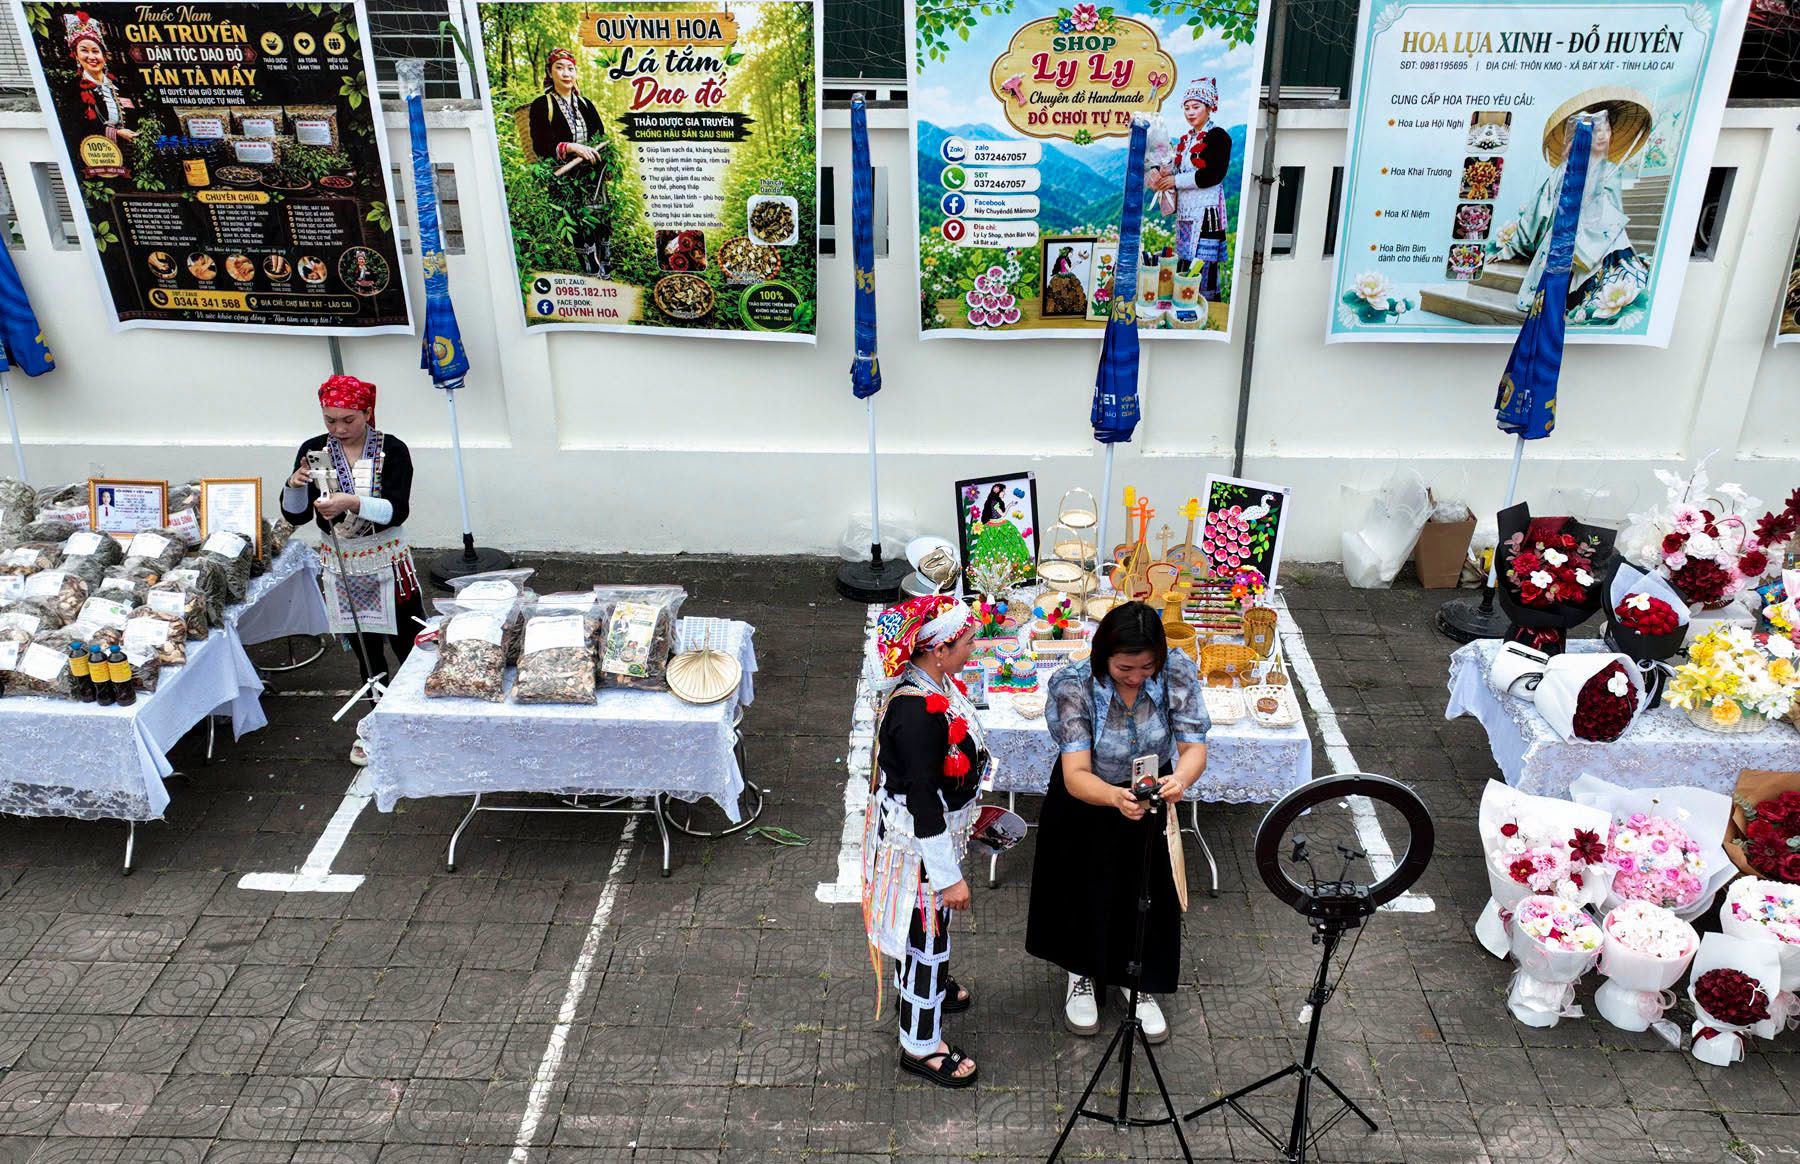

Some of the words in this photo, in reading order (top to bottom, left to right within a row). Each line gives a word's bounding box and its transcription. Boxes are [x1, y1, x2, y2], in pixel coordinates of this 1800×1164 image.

[135, 5, 174, 22] Thuốc
[177, 5, 212, 22] Nam
[125, 24, 162, 43] GIA
[164, 20, 248, 43] TRUYỀN
[597, 14, 670, 42] QUỲNH
[677, 19, 722, 39] HOA
[1053, 36, 1116, 52] SHOP
[1400, 31, 1449, 53] HOA
[1452, 31, 1493, 58] LỤA
[1496, 31, 1553, 53] XINH
[1568, 24, 1600, 53] ĐỖ
[1604, 24, 1684, 53] HUYỀN
[146, 46, 172, 61] DÂN
[174, 45, 197, 63] TỘC
[200, 48, 224, 61] DAO
[226, 45, 243, 61] ĐỎ
[609, 47, 659, 79] Lá
[665, 45, 723, 73] tắm
[1400, 60, 1417, 70] SĐT:
[1420, 61, 1468, 70] 0981195695
[1486, 61, 1499, 72] ĐỊA
[1520, 59, 1542, 70] THÔN
[1582, 60, 1596, 70] BÁT
[1599, 60, 1614, 70] XÁT
[1642, 60, 1659, 70] LÀO
[1660, 62, 1675, 70] CAI
[1031, 53, 1079, 89] Ly
[1088, 53, 1134, 89] Ly
[629, 76, 688, 110] Dao
[1030, 91, 1069, 108] Chuyên
[1072, 90, 1085, 104] đồ
[1088, 91, 1144, 104] Handmade
[1391, 94, 1418, 105] CUNG
[1421, 92, 1440, 105] CẤP
[1442, 95, 1463, 105] HOA
[1465, 95, 1490, 105] THEO
[1493, 94, 1511, 105] YÊU
[1514, 92, 1536, 105] CẦU:
[634, 115, 657, 127] THẢO
[660, 117, 683, 128] DƯỢC
[685, 118, 700, 126] GIA
[701, 115, 734, 127] TRUYỀN
[1028, 105, 1049, 125] ĐỒ
[1052, 110, 1087, 124] CHƠI
[1091, 109, 1111, 127] TỰ
[1115, 111, 1132, 127] TẠ
[664, 130, 680, 140] HẬU
[682, 128, 697, 138] SẢN
[87, 143, 111, 151] 100%
[974, 153, 1026, 161] 0372467057
[1408, 168, 1424, 176] Khai
[974, 180, 1026, 188] 0372467057
[205, 192, 236, 201] CHUYÊN
[1384, 210, 1399, 218] Hoa
[1411, 210, 1430, 219] Niệm
[1379, 244, 1394, 252] Hoa
[1395, 244, 1410, 252] Bim
[1378, 254, 1395, 263] dành
[1397, 254, 1410, 262] cho
[1412, 254, 1430, 263] thiếu
[1432, 255, 1443, 263] nhi
[556, 287, 617, 297] 0985.182.113
[760, 291, 784, 300] 100%
[174, 297, 199, 306] 0344
[202, 298, 219, 307] 341
[222, 299, 240, 308] 568
[558, 305, 594, 317] QUỲNH
[597, 308, 618, 317] HOA
